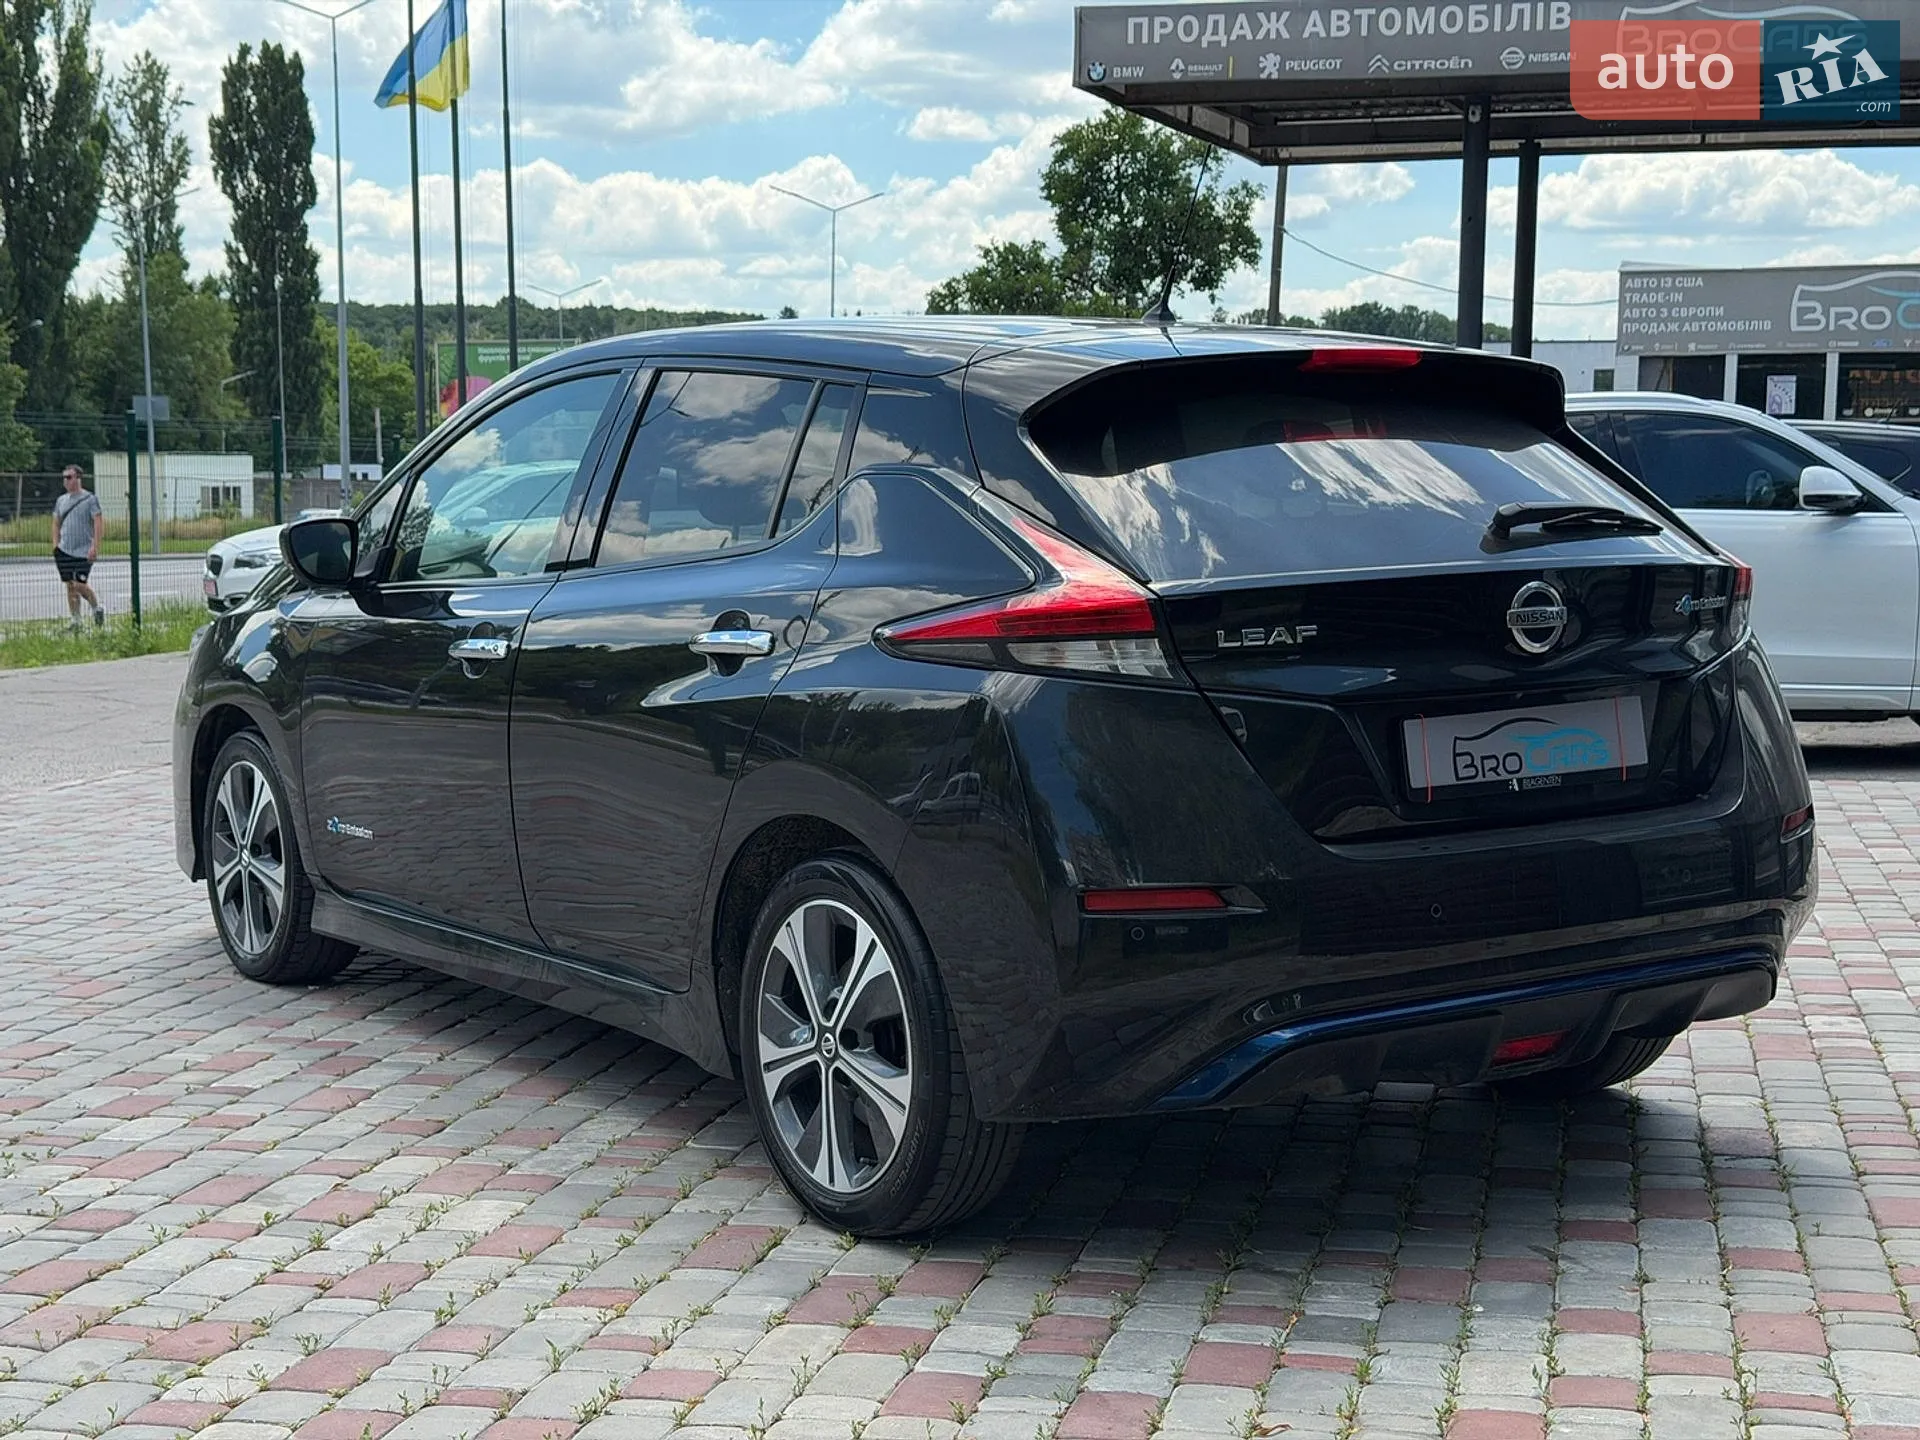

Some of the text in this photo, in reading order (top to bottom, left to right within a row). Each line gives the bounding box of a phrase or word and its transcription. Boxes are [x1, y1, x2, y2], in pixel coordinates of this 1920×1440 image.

[1126, 1, 1571, 48] ПРОДАЖ АВТОМОБІЛІВ
[1528, 52, 1577, 63] NISSAN
[1187, 64, 1224, 73] RENAULT
[1285, 58, 1343, 71] PEUGEOT
[1113, 66, 1144, 78] BMW
[1625, 277, 1657, 288] АВТО
[1675, 276, 1704, 288] США
[1624, 292, 1683, 304] TRADE-IN
[1623, 308, 1657, 319] АВТО
[1623, 320, 1772, 334] ПРОДАЖ АВТОМОБІЛІВ
[1515, 608, 1563, 624] NISSAN
[1216, 625, 1318, 647] LEAF
